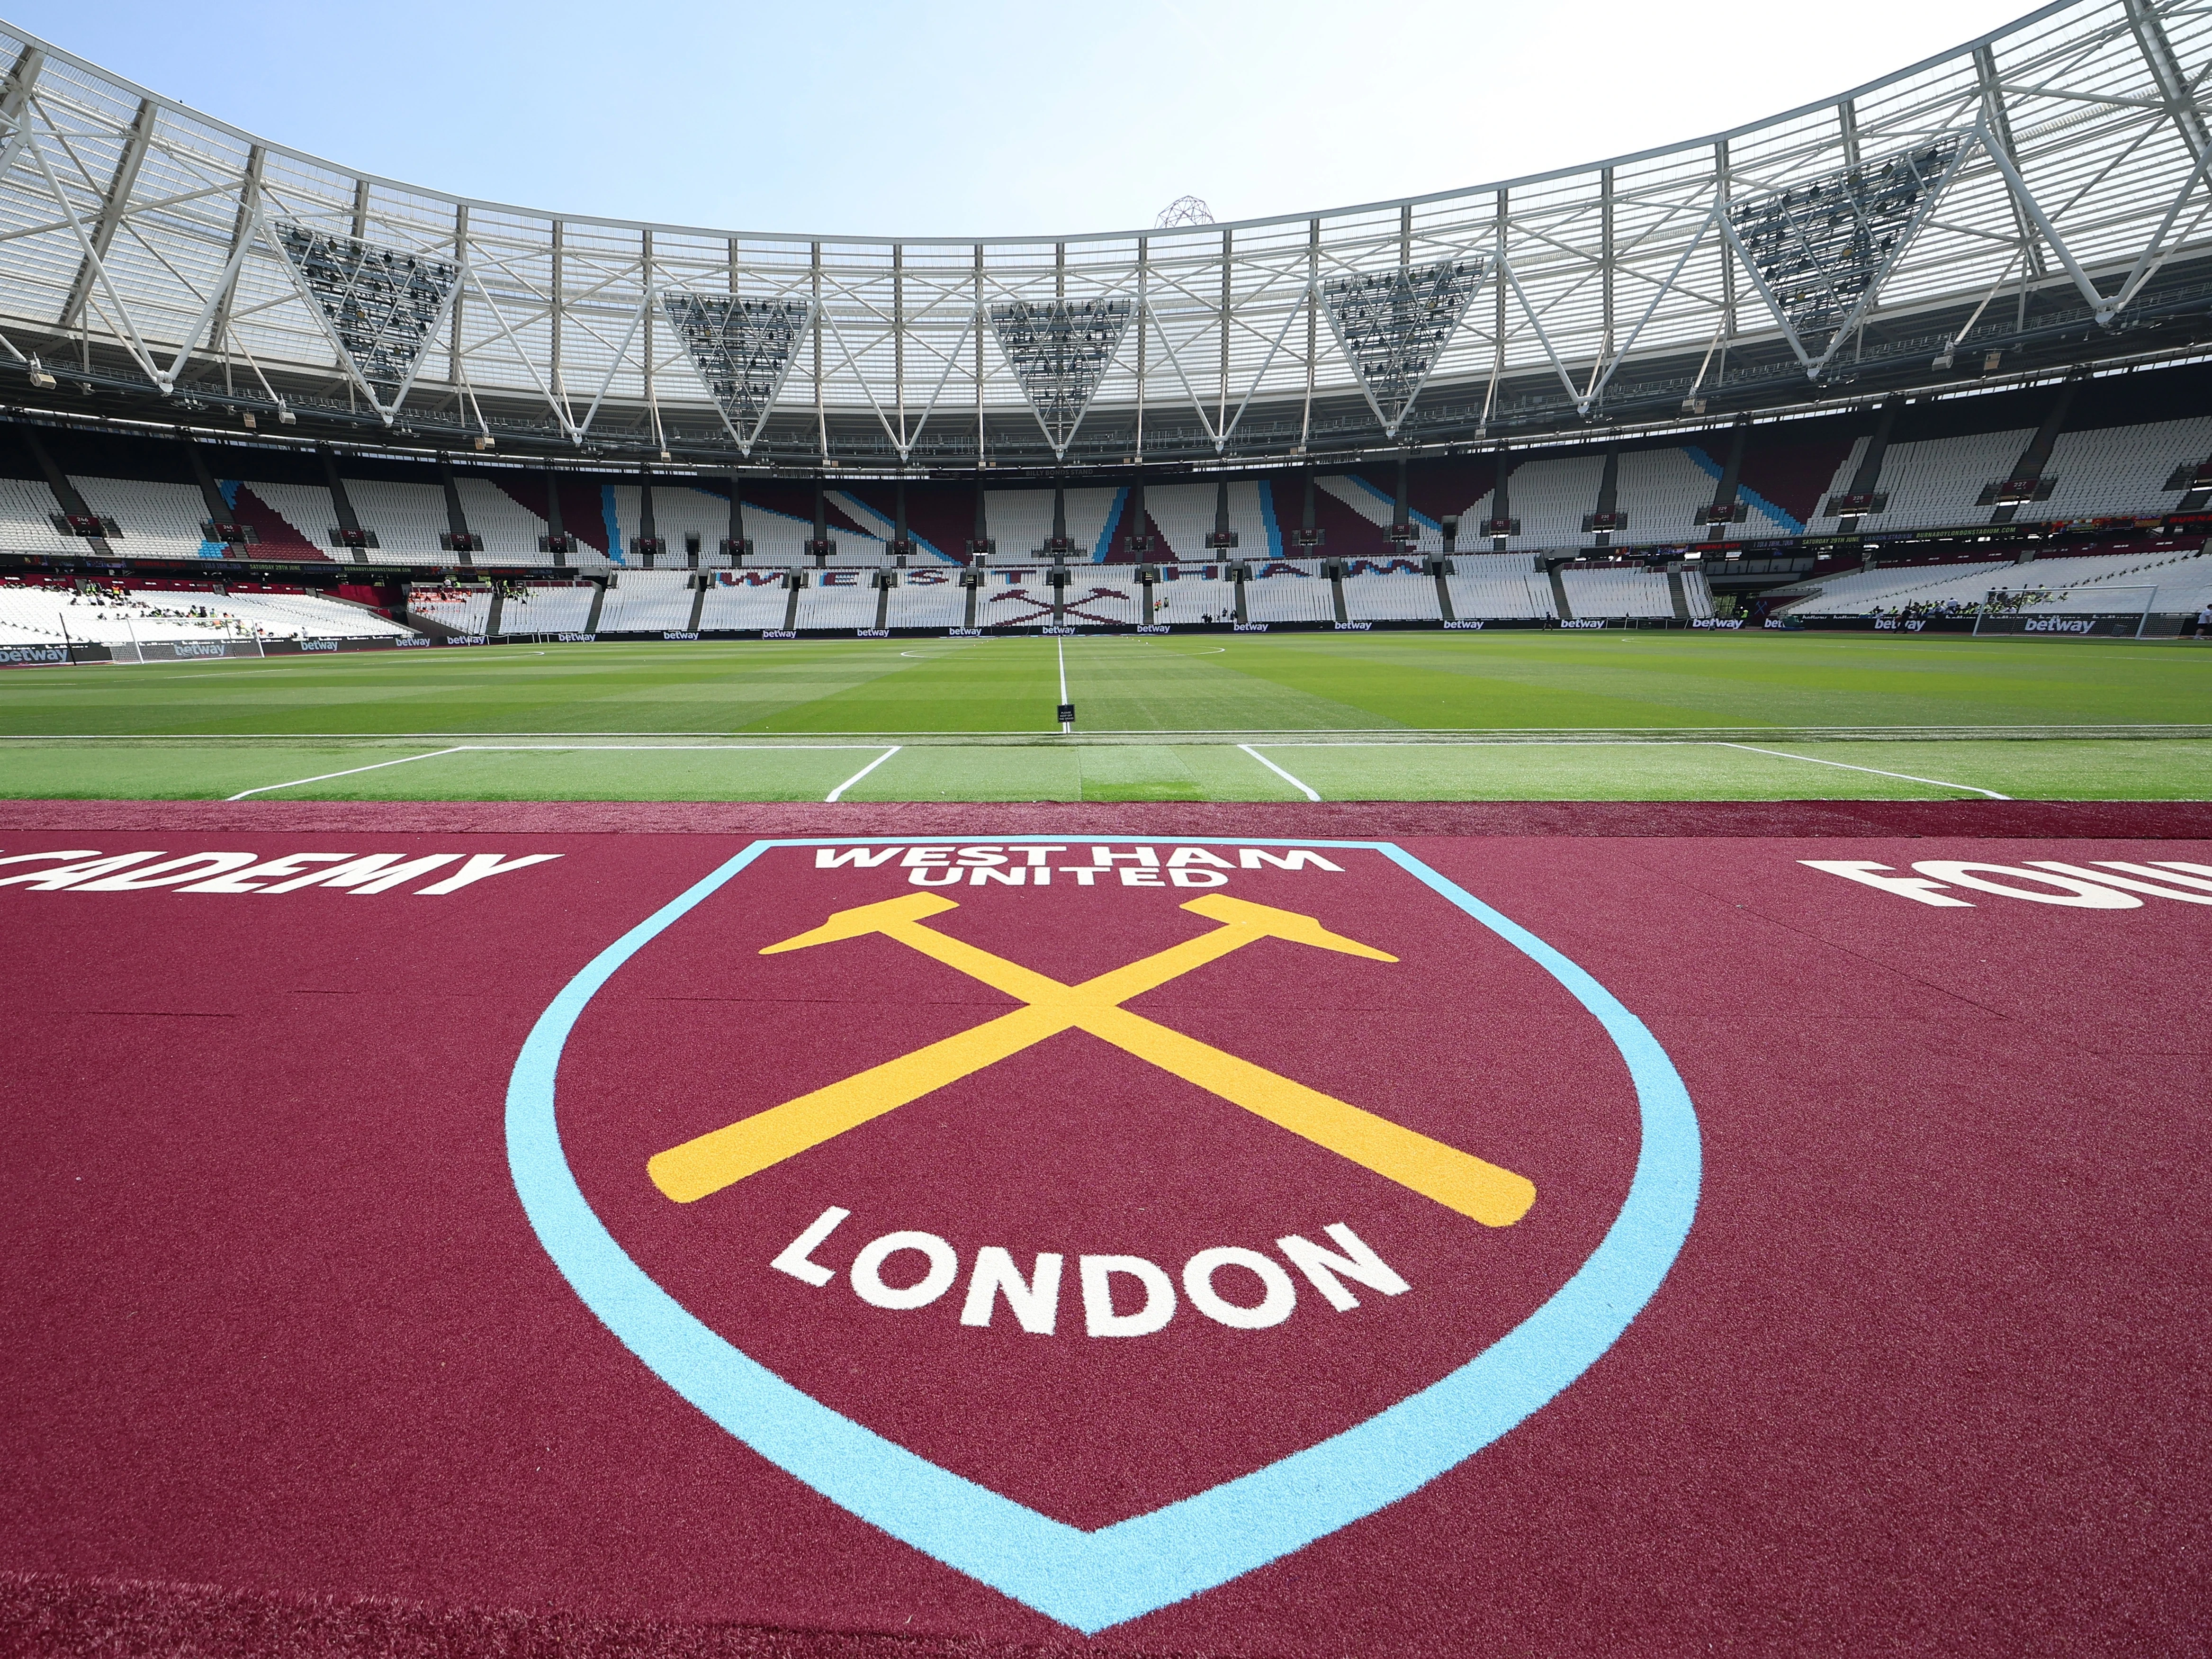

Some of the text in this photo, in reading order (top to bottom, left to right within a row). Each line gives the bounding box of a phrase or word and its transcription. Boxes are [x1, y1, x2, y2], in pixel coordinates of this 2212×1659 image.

[1916, 527, 2016, 538] BURNABOYLONDONSTADIUM.COM
[1137, 625, 1170, 633] betway
[1233, 623, 1268, 631] betway
[1335, 621, 1372, 631] betway
[1444, 620, 1484, 630] betway
[1561, 619, 1605, 629] betway
[1692, 618, 1744, 630] betway
[2024, 618, 2096, 633] betway
[664, 631, 699, 640] betway
[763, 630, 797, 639] betway
[857, 628, 890, 637] betway
[949, 627, 982, 636] betway
[1043, 626, 1075, 635] betway
[396, 638, 430, 647] betway
[447, 636, 485, 645] betway
[558, 633, 596, 642] betway
[174, 644, 225, 657] betway
[300, 640, 338, 651] betway
[815, 846, 1346, 872] WEST HAM
[908, 866, 1228, 888] UNITED
[1796, 860, 2212, 910] FOU
[770, 1206, 1412, 1338] LONDON
